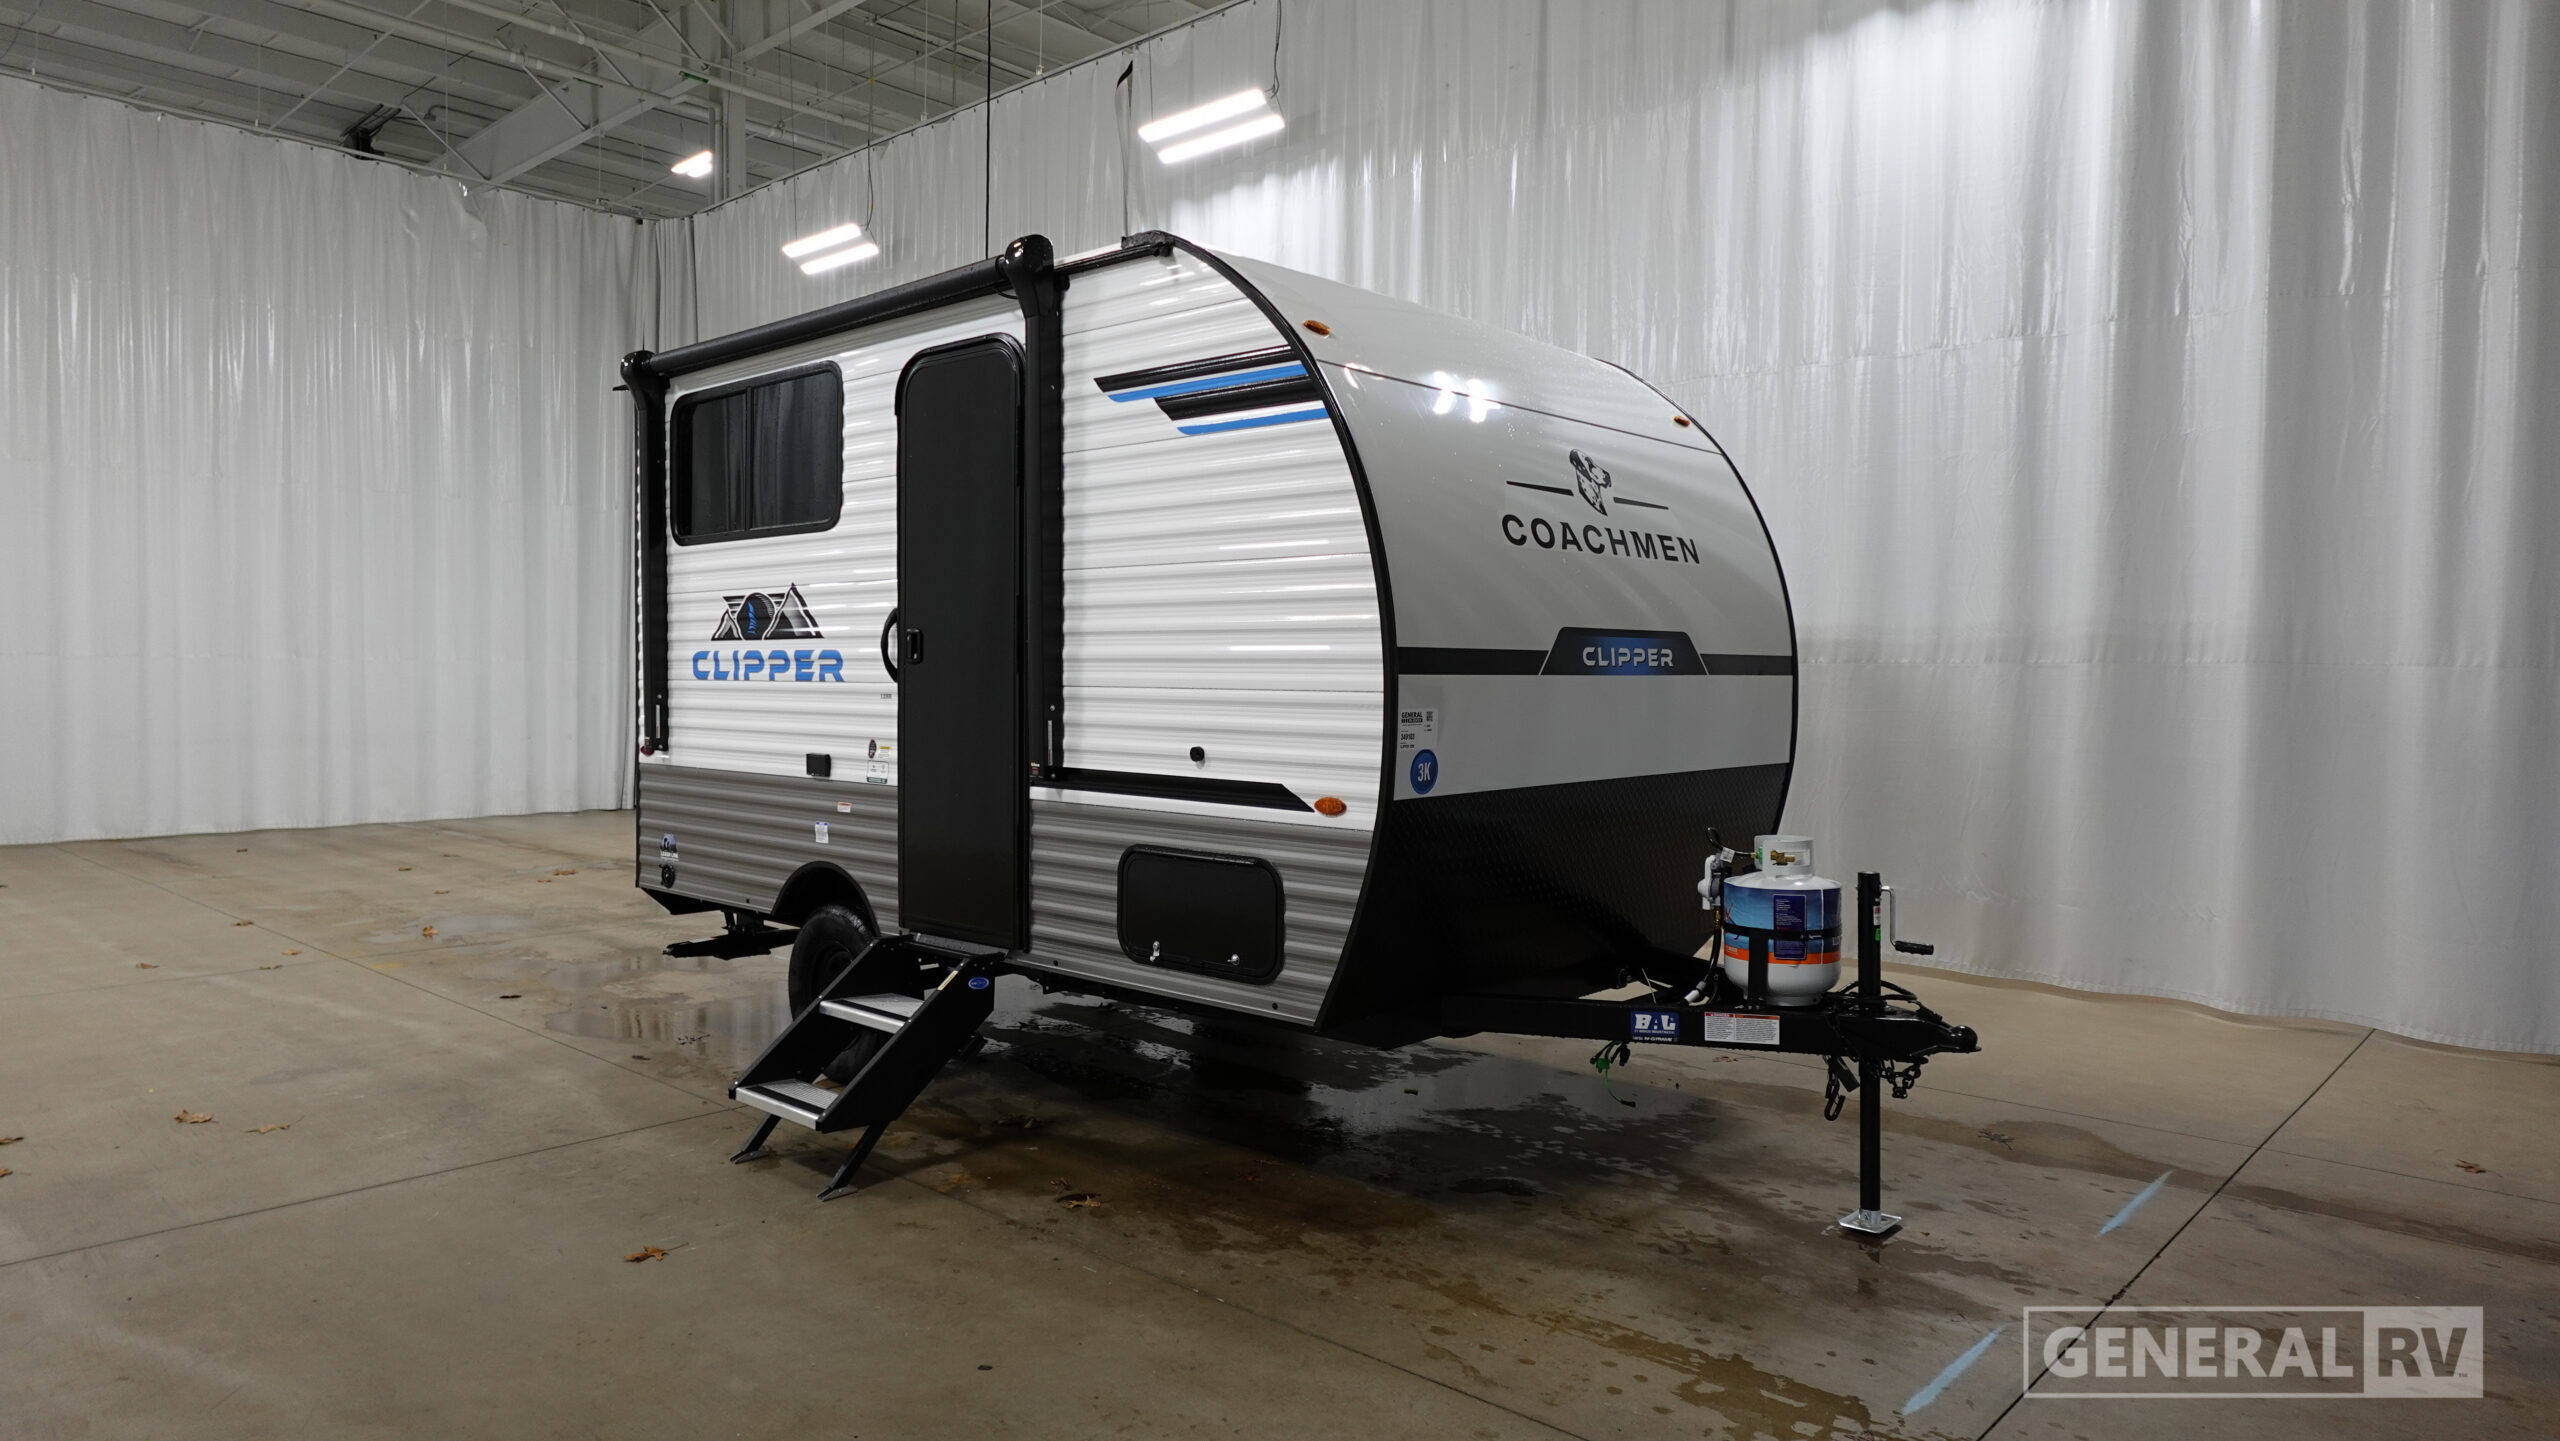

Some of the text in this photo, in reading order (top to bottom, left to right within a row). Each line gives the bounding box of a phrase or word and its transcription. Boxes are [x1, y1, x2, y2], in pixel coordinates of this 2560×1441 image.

[1501, 513, 1701, 565] COACHMEN
[692, 649, 845, 683] CLIPPER
[1582, 646, 1675, 668] CLIPPER
[1418, 763, 1432, 782] 3K
